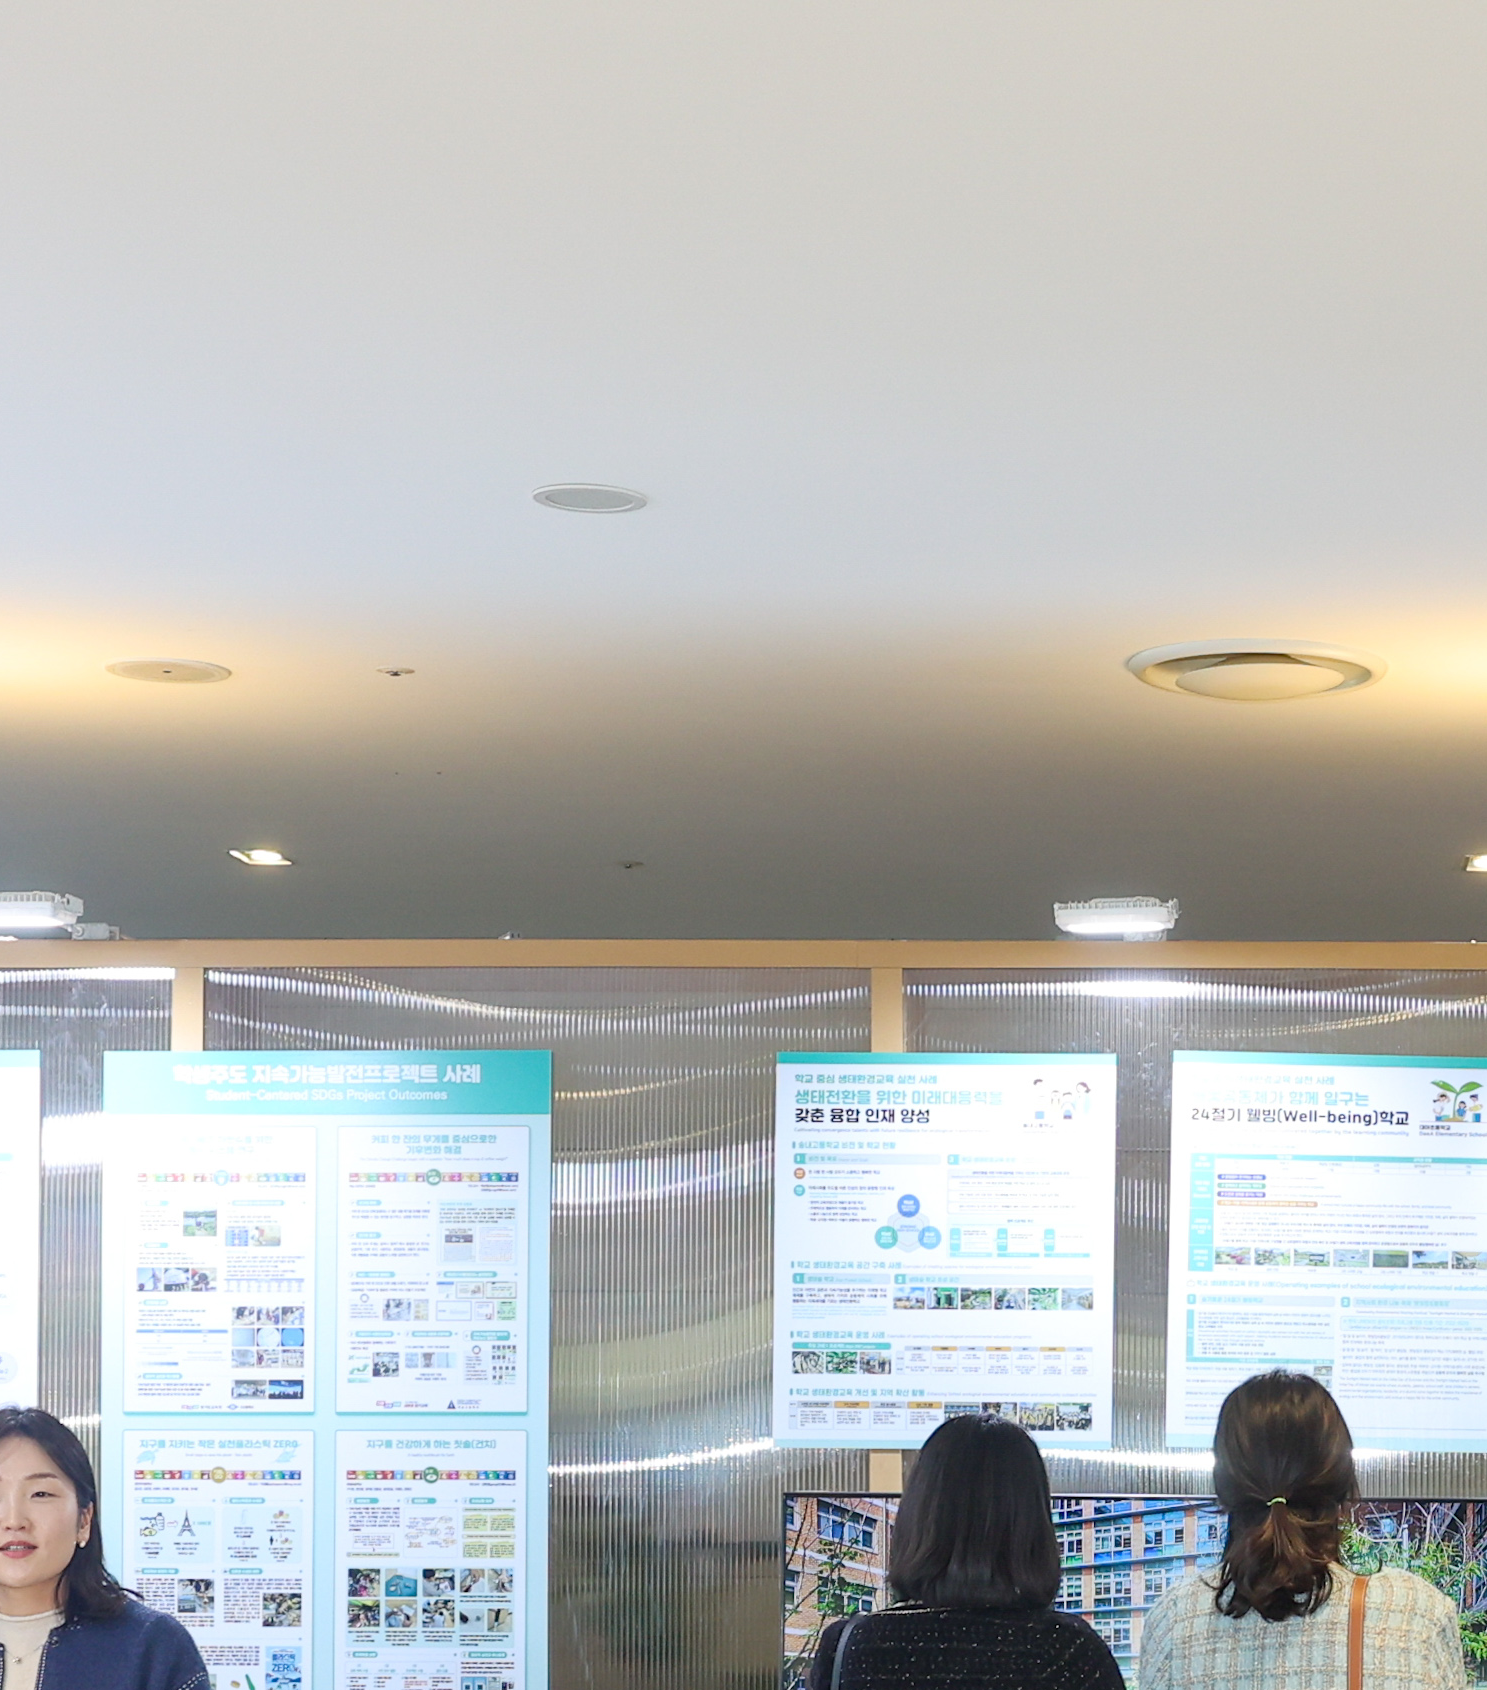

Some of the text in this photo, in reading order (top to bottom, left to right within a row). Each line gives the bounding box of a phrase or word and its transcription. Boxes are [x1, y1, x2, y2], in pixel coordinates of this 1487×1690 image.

[252, 1065, 439, 1084] 지속가능발전프로젝트
[442, 1065, 482, 1084] 사례
[206, 1089, 448, 1102] Student-Centered SDGs Project Outcomes
[794, 1090, 871, 1105] 생태전환을
[876, 1090, 907, 1105] 위한
[1324, 1091, 1369, 1107] 일구는
[795, 1108, 930, 1124] 갖춘 융합 인재 양성
[1191, 1108, 1410, 1126] 24절기 웰빙(Well-being)학교
[169, 1439, 298, 1449] 지키는 ZERO
